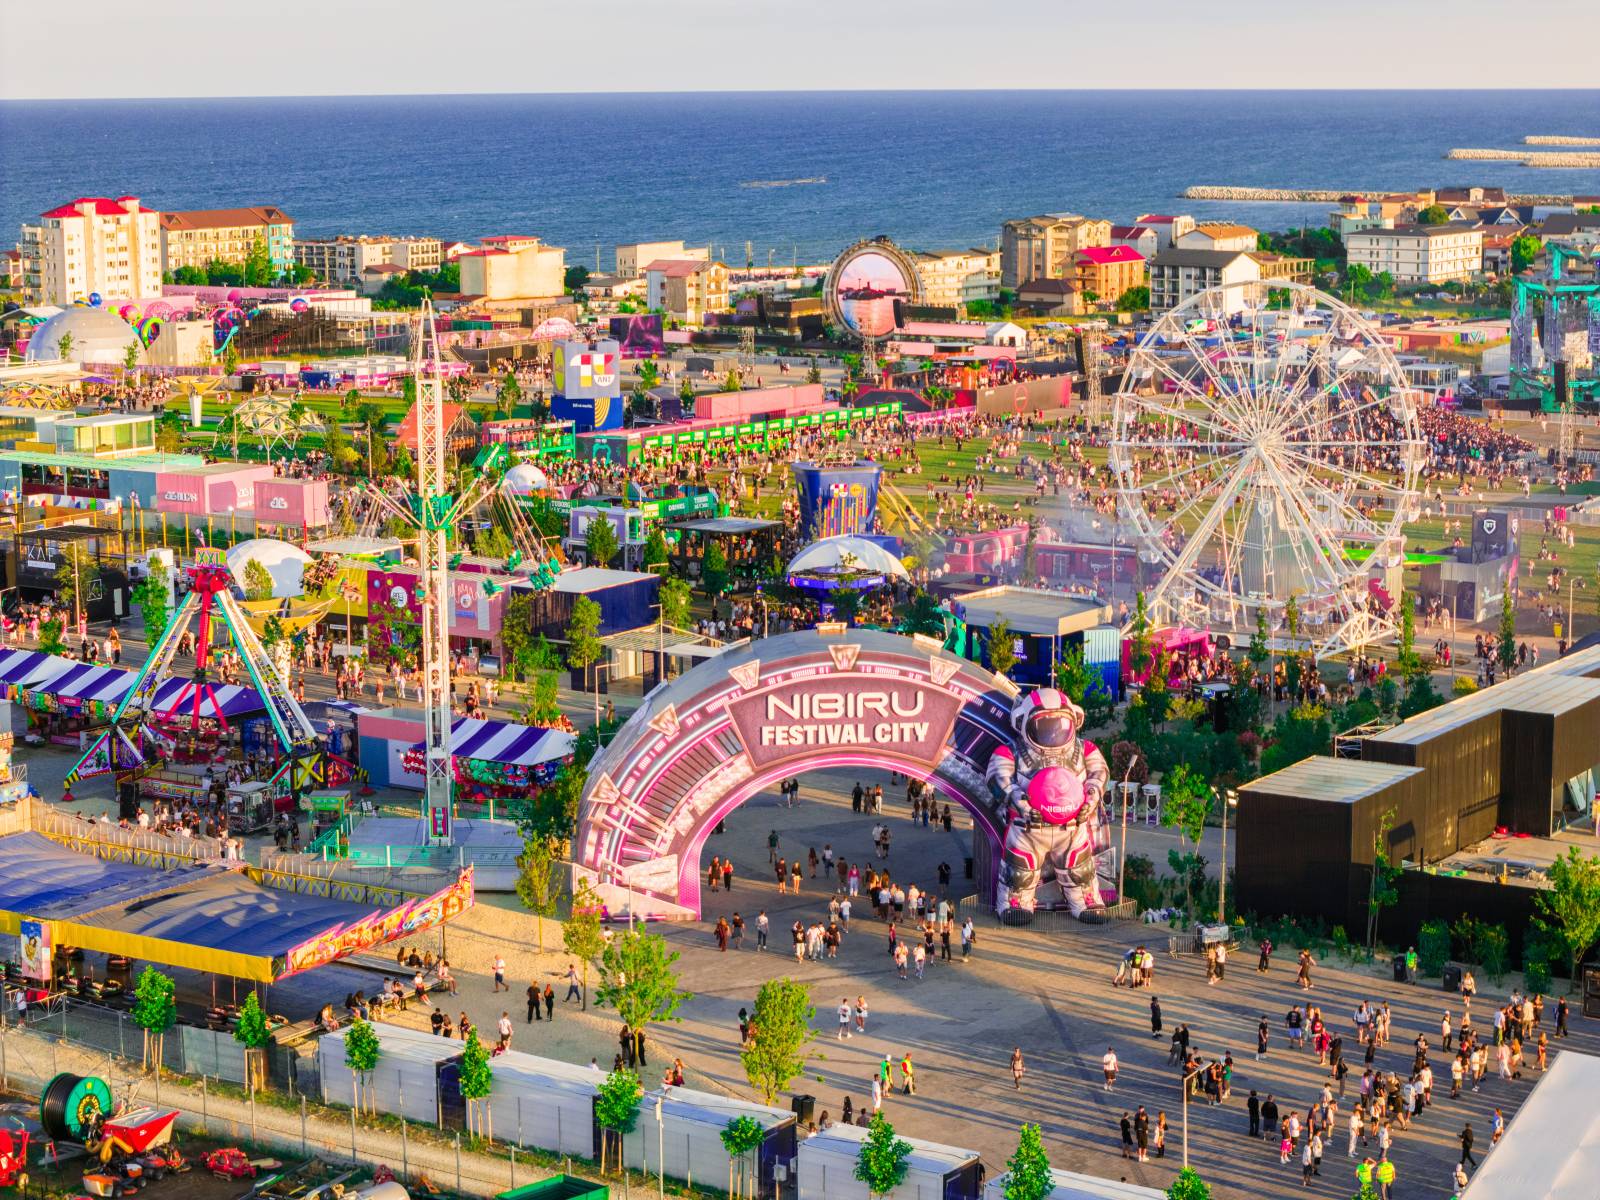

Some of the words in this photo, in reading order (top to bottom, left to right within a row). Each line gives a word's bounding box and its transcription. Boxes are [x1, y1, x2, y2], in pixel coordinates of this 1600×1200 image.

[198, 551, 225, 568] XXL
[767, 690, 924, 720] NIBIRU
[761, 723, 870, 746] FESTIVAL
[875, 722, 929, 743] CITY
[1041, 803, 1080, 814] NIBIRU
